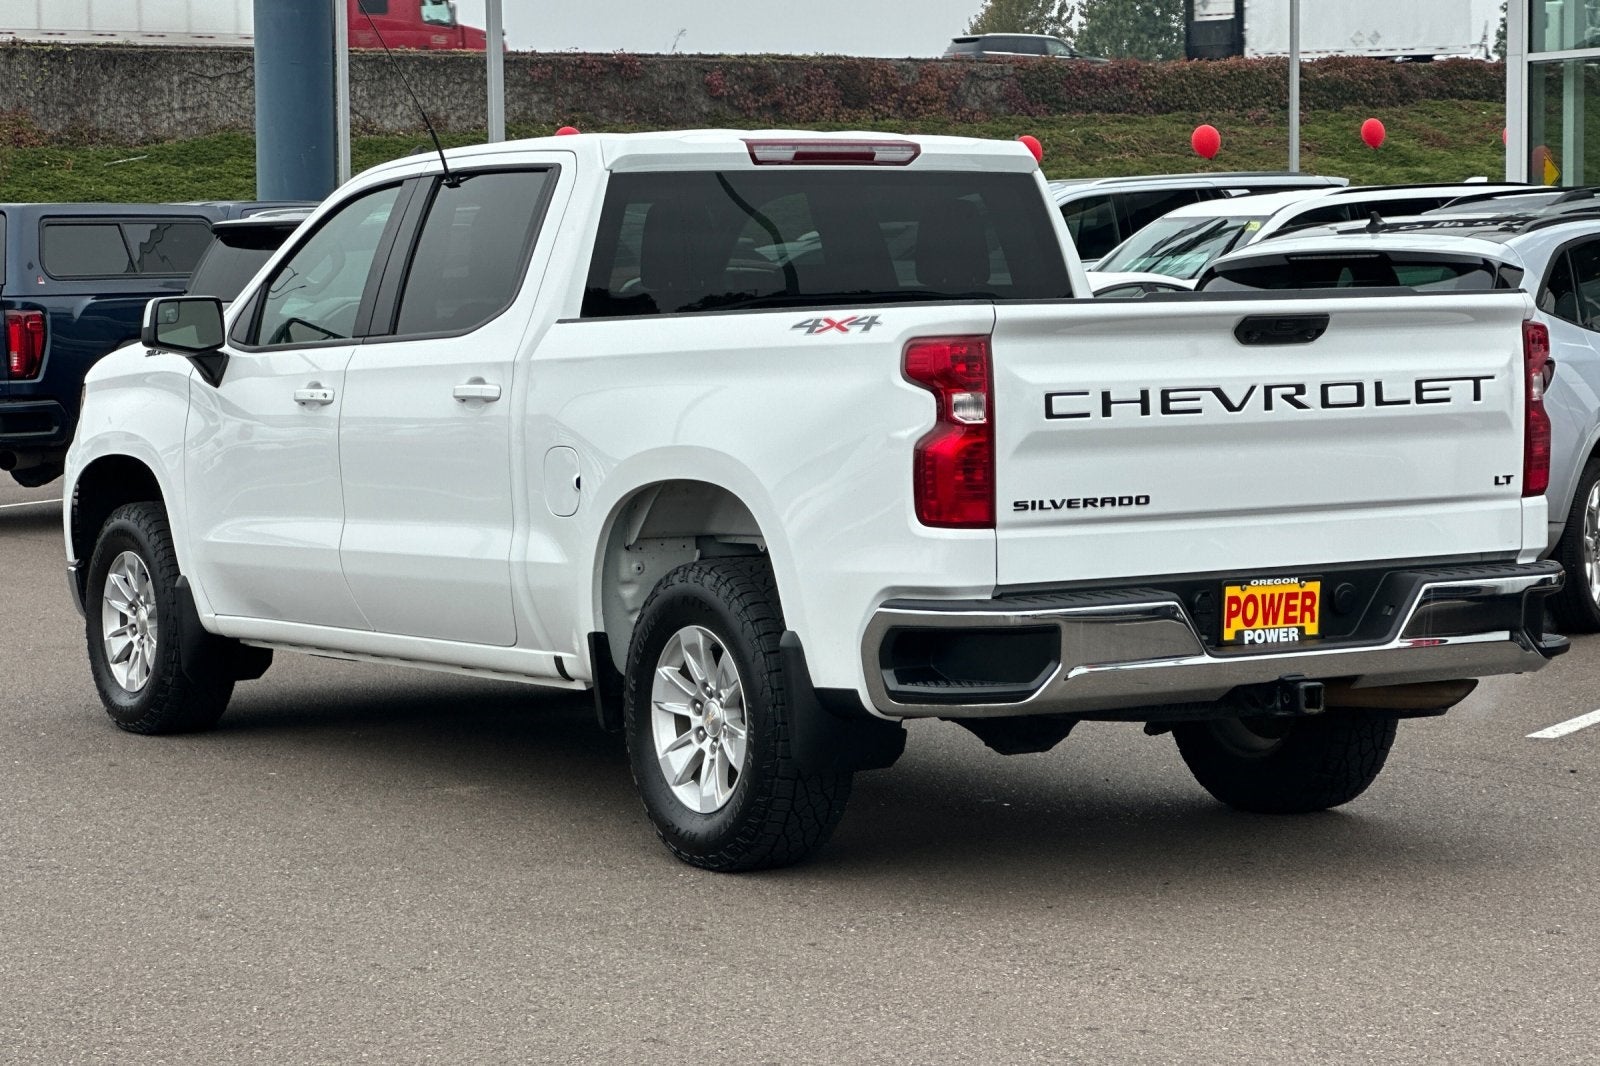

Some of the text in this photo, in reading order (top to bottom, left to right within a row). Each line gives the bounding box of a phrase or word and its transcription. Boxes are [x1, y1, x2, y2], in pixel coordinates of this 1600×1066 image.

[1044, 375, 1496, 420] CHEVROLET
[1494, 475, 1514, 485] LT
[1012, 494, 1151, 512] SILVERADO
[1250, 577, 1299, 586] OREGON
[1225, 590, 1317, 629] POWER
[1244, 627, 1299, 644] POWER
